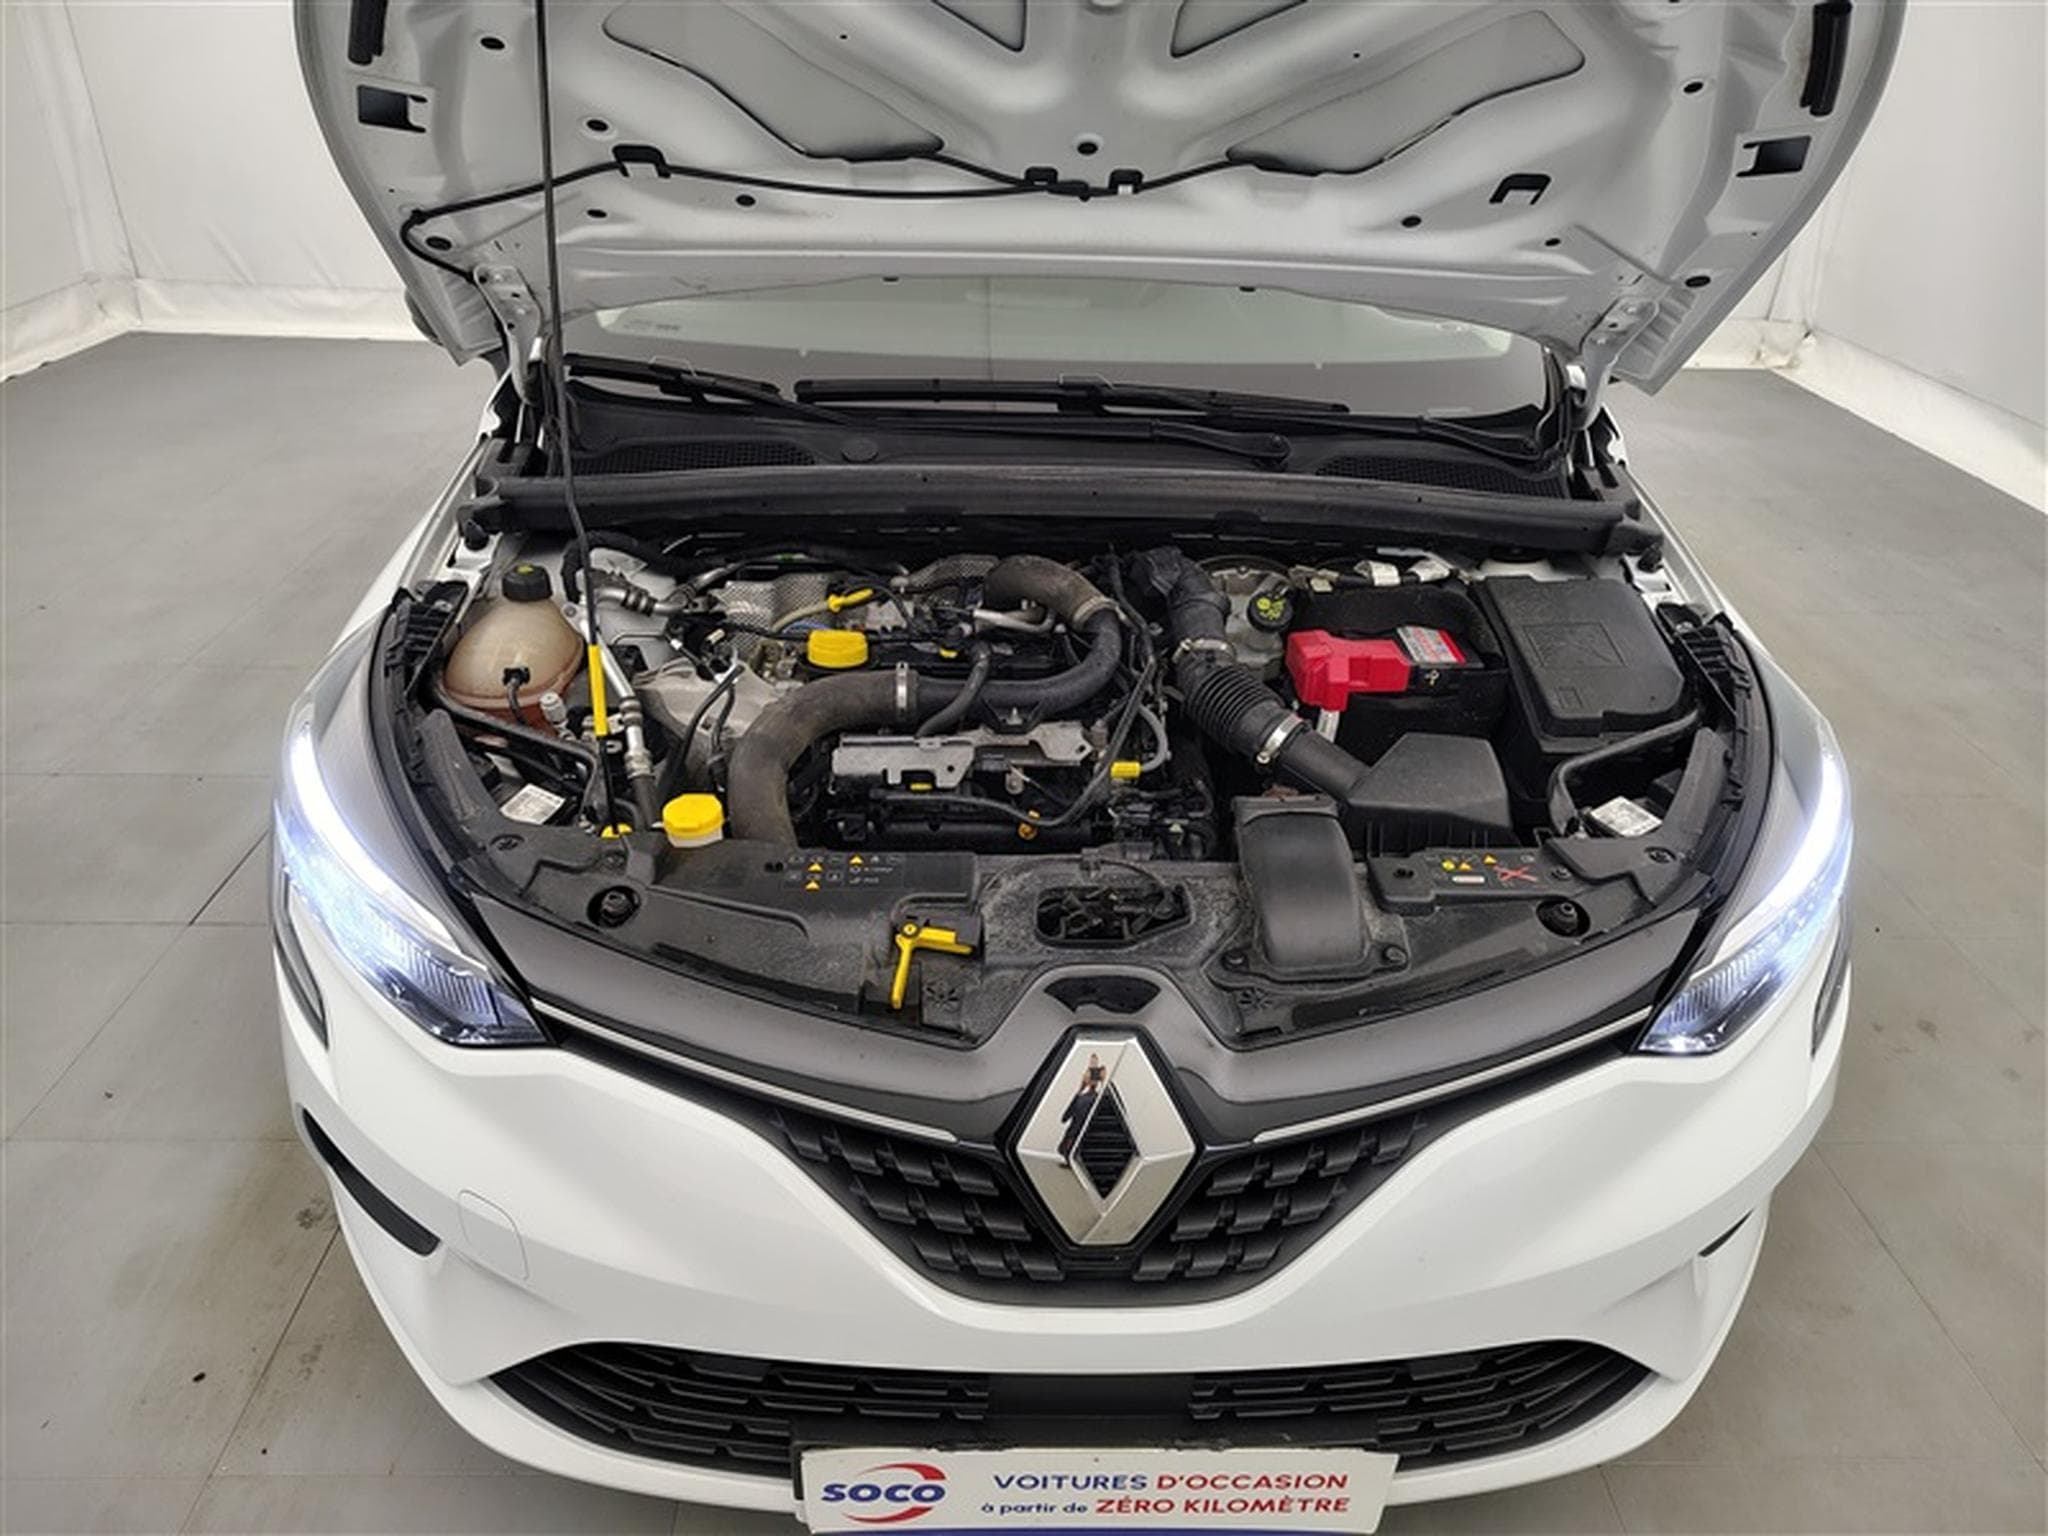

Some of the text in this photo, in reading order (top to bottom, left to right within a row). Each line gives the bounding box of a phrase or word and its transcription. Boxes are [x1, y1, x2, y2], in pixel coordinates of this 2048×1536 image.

[993, 1474, 1349, 1490] VOITURES D'OCCASION
[821, 1483, 946, 1502] SOCO
[981, 1495, 1350, 1514] à partir de ZÉRO KILOMÈTRE
